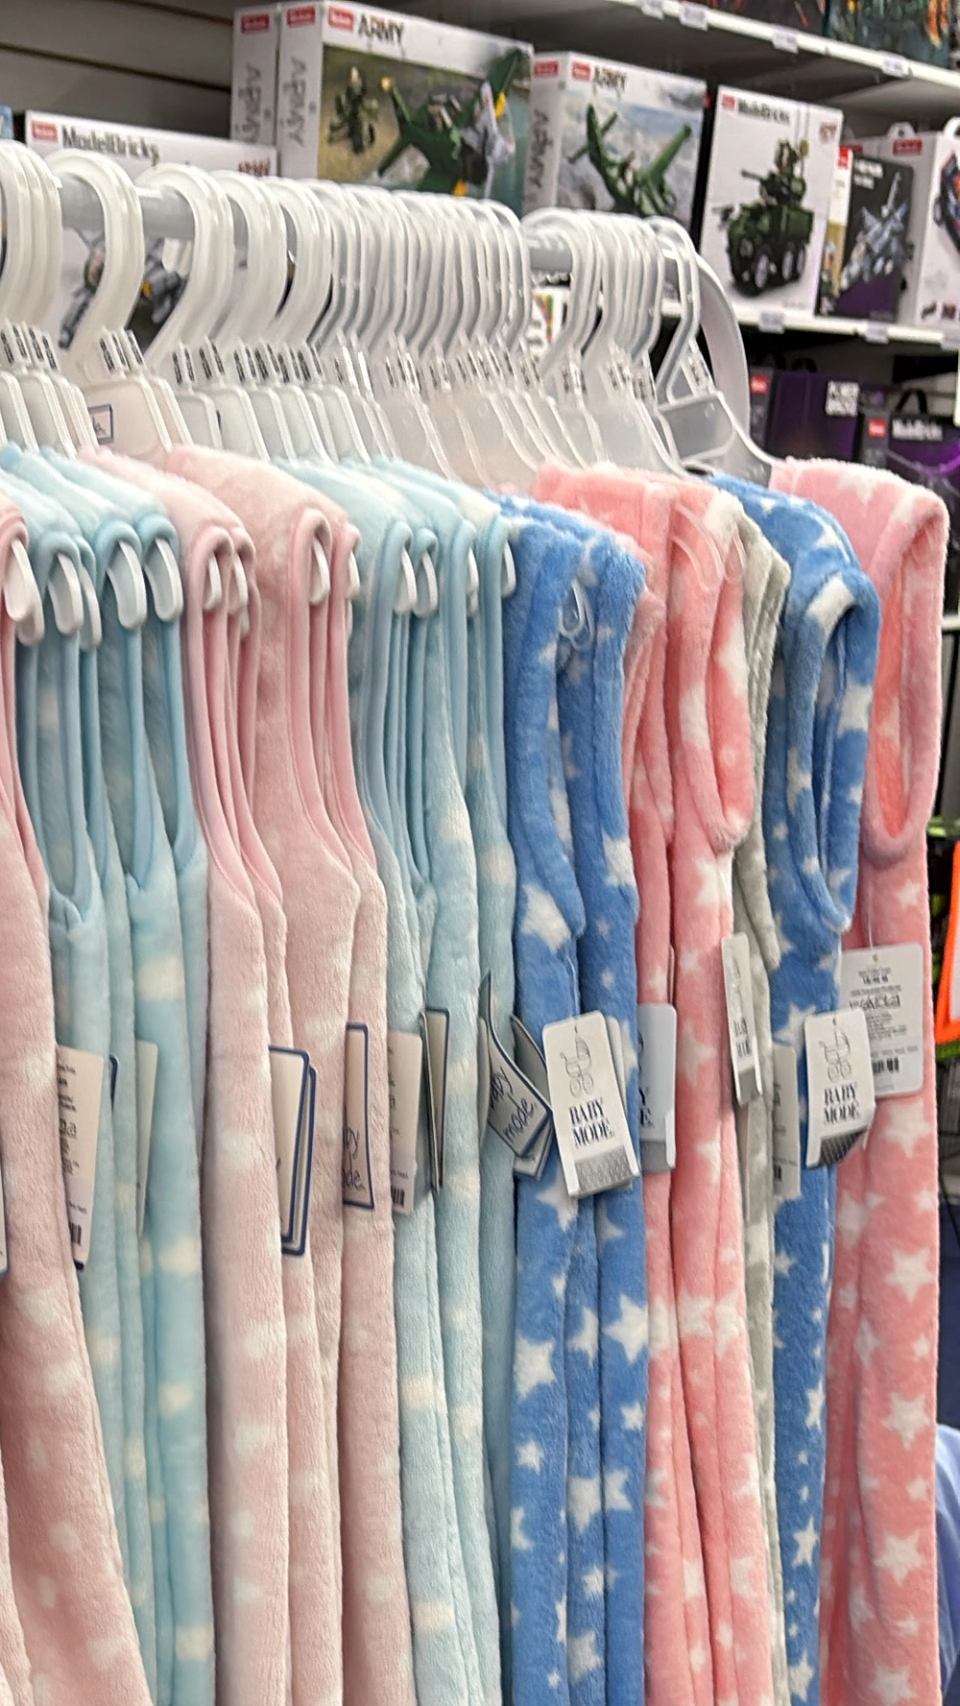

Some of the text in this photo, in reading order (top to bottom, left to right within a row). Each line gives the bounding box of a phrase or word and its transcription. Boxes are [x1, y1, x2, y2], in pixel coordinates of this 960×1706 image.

[359, 14, 404, 43] ARMY
[823, 1082, 858, 1106] BABY
[569, 1097, 605, 1124] BABY
